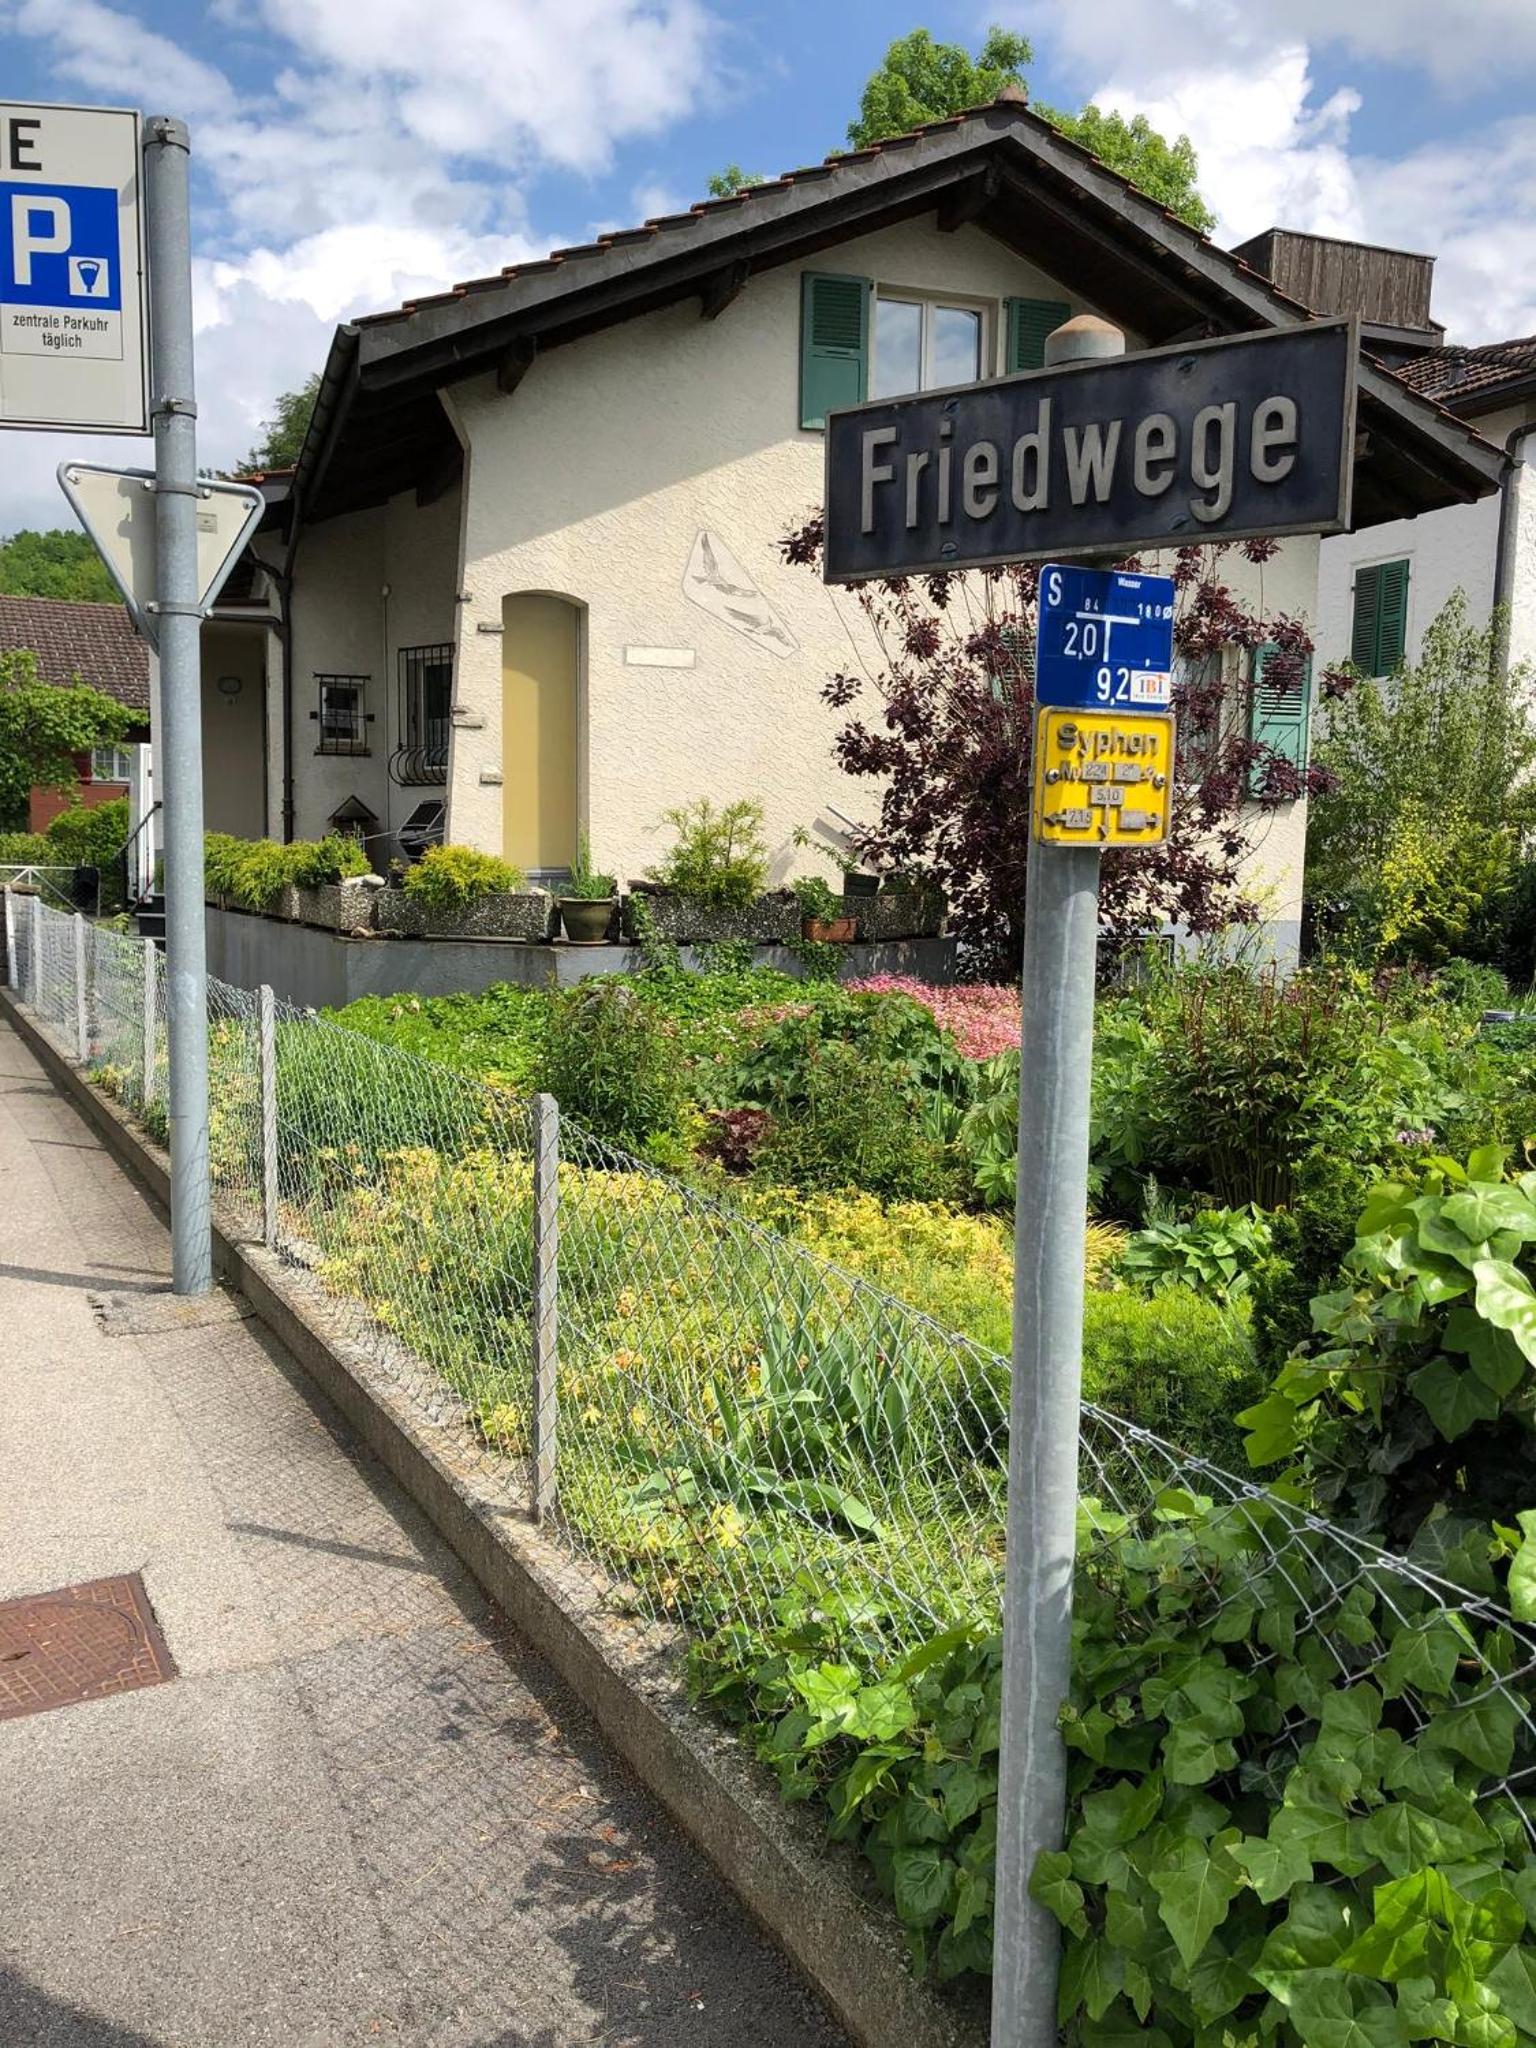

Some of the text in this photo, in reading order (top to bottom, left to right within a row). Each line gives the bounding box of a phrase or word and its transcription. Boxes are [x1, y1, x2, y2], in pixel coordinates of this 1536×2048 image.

[0, 118, 42, 171] E
[11, 194, 72, 285] P
[13, 315, 109, 331] zentrale Parkuhr
[42, 332, 83, 349] täglich
[861, 395, 1298, 534] Friedwege
[1048, 572, 1063, 606] S
[1063, 622, 1097, 660] 2,0
[1097, 667, 1129, 706] 9,2
